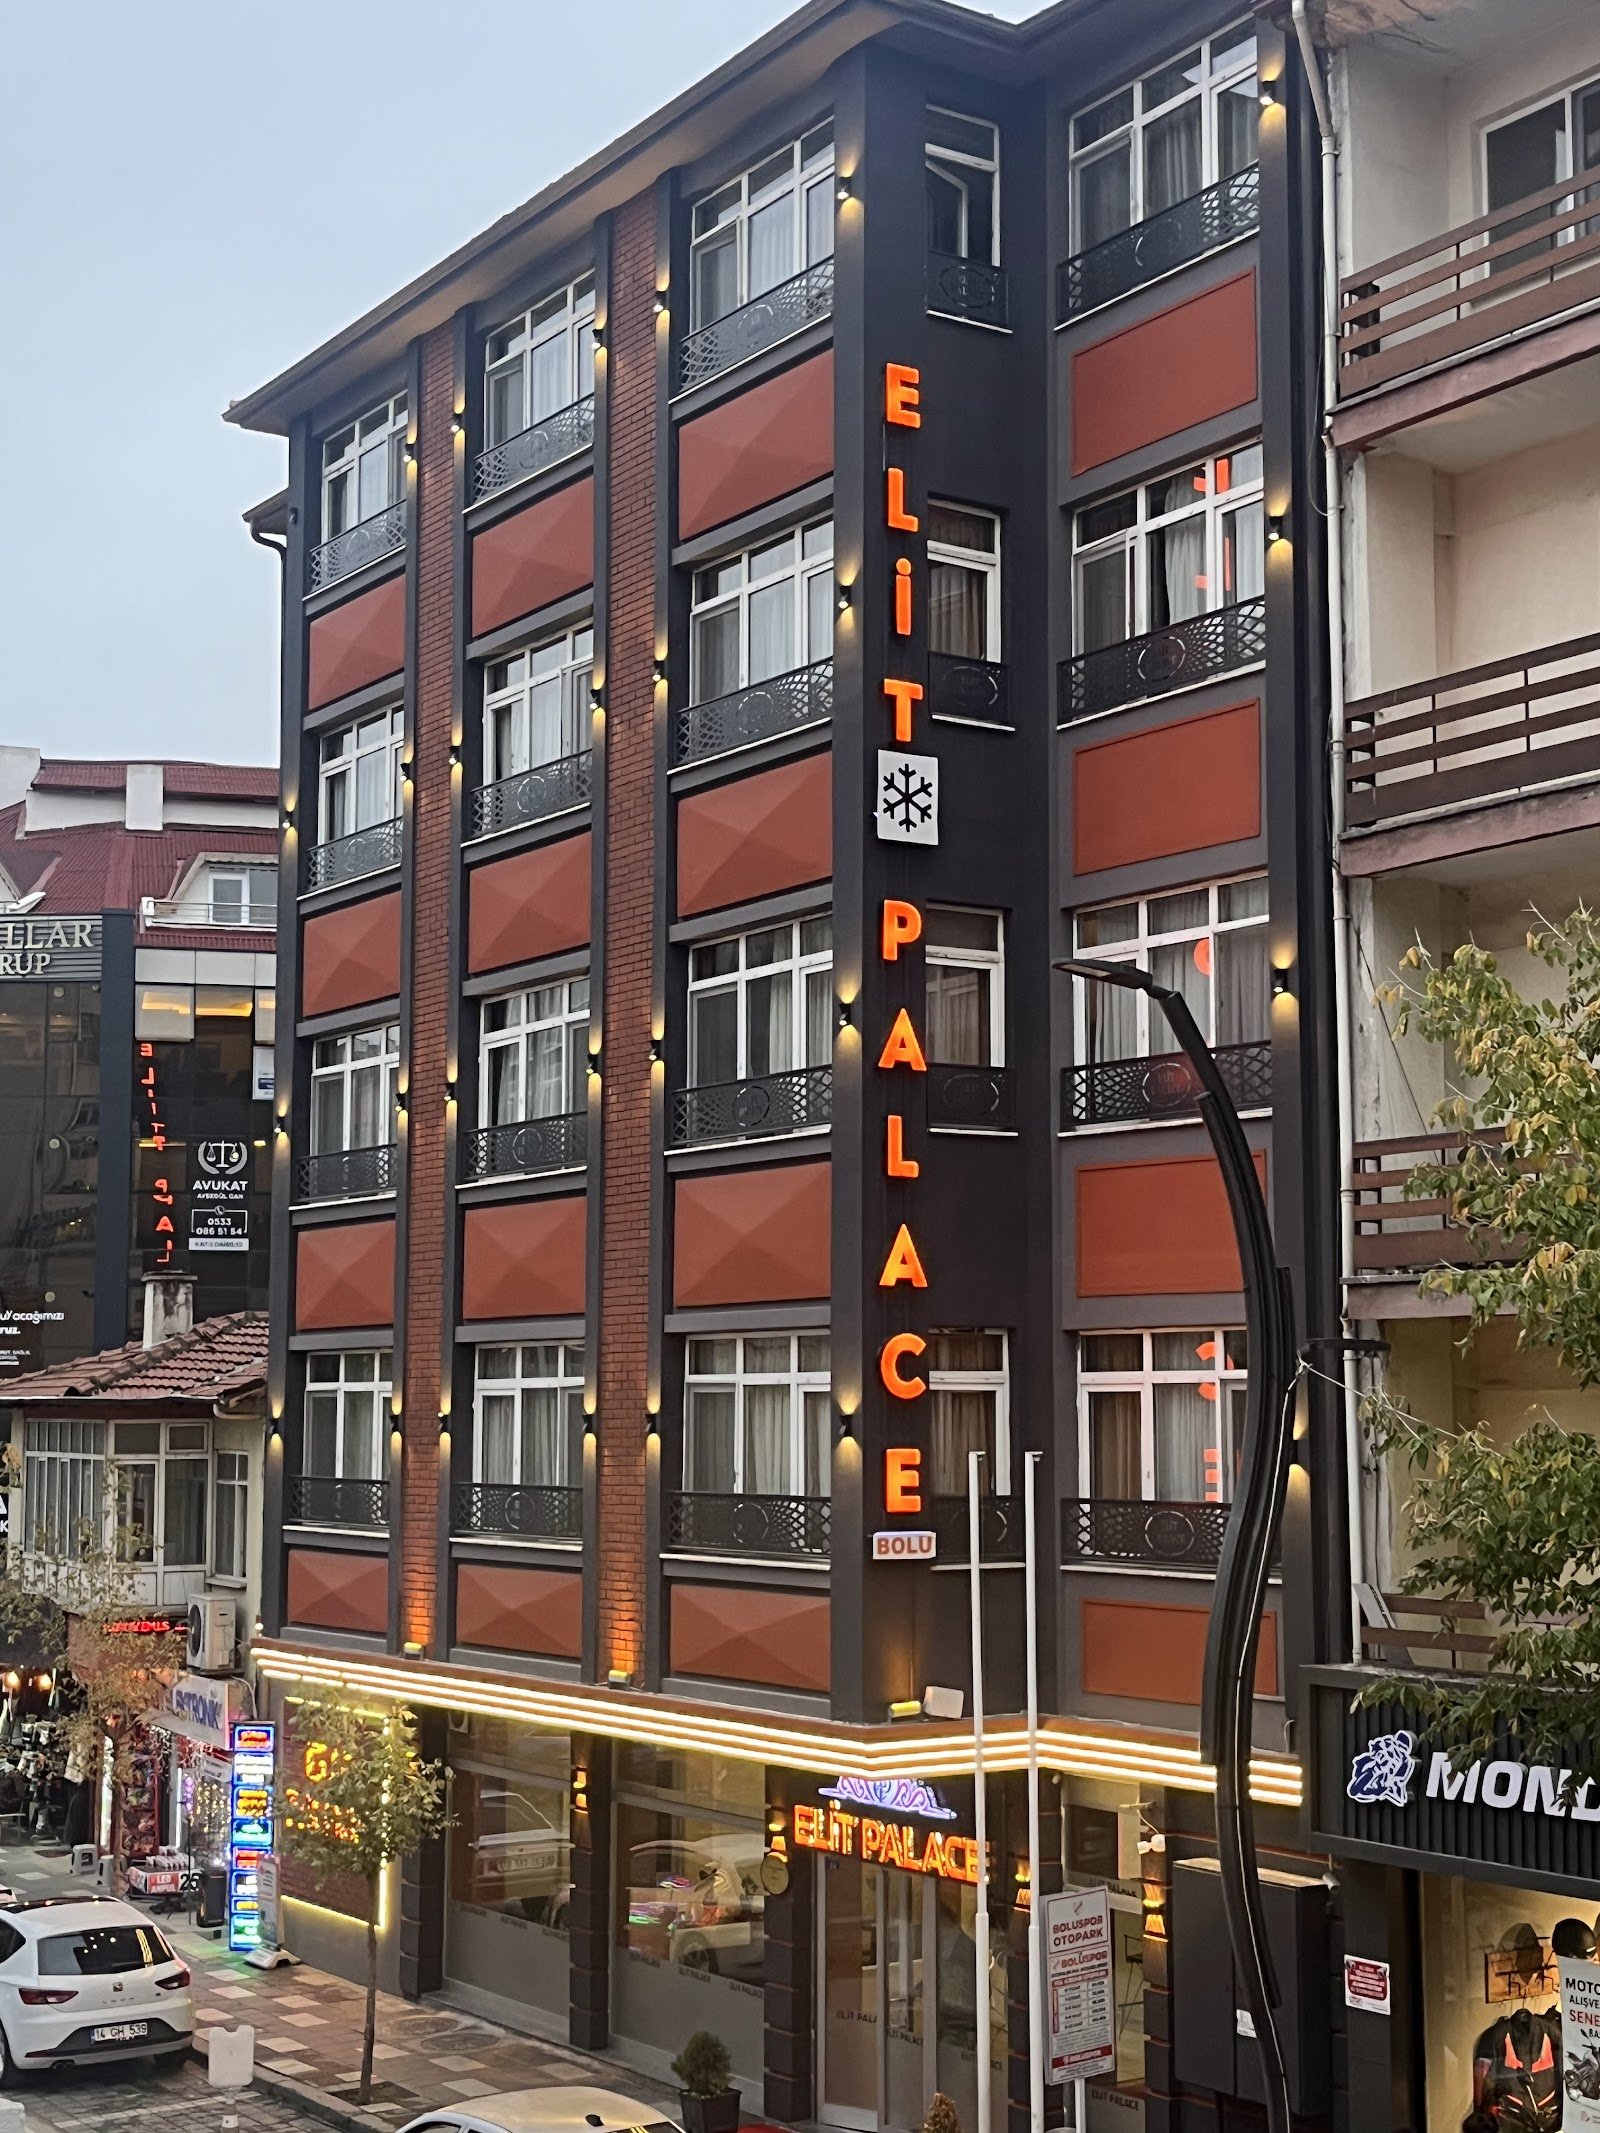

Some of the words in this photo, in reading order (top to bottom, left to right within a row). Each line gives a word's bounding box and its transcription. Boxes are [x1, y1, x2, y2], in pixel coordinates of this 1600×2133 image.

[0, 921, 95, 950] LLAR
[192, 1180, 249, 1191] AVUKAT
[877, 899, 930, 1515] PALACE
[207, 1217, 232, 1226] 0533
[230, 1227, 243, 1235] 54
[877, 1535, 932, 1555] BOLU
[861, 1817, 981, 1884] PALACE
[1052, 1915, 1103, 1934] BOLUSPOR
[1053, 1927, 1103, 1947] OTOPARK
[1061, 1951, 1107, 1969] BOLUSPOR
[110, 2026, 125, 2037] GH
